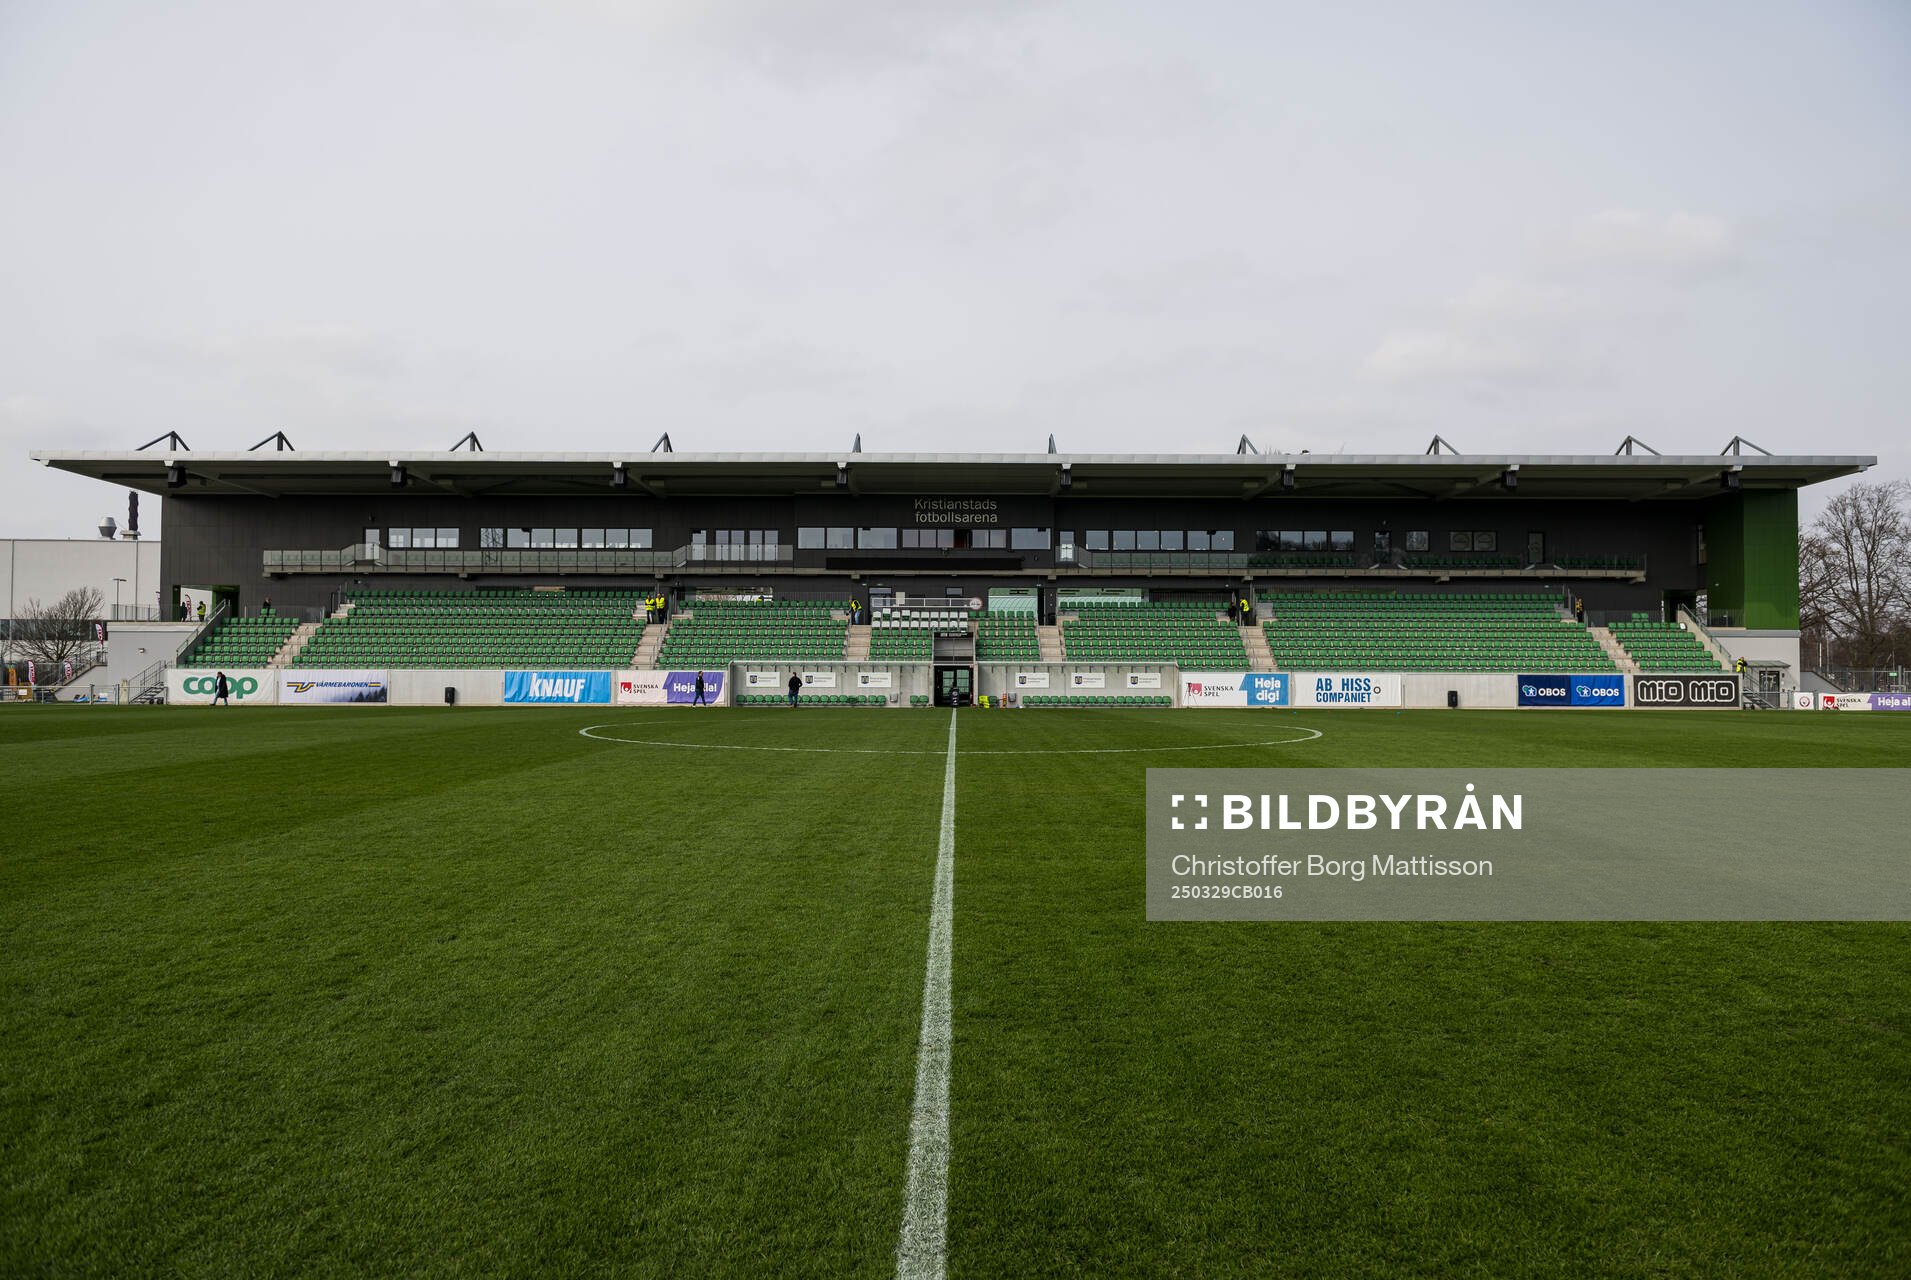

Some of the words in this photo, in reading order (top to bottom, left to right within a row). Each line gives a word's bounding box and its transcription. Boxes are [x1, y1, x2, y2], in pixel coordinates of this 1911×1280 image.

[914, 499, 998, 510] Kristianstads
[915, 511, 998, 523] fotbollsarena
[529, 673, 586, 702] KNAUF
[673, 682, 696, 694] Heja
[1254, 677, 1281, 689] Heja
[1316, 678, 1333, 691] AB
[1341, 678, 1371, 691] HISS
[1256, 690, 1280, 703] dig!
[1316, 692, 1371, 703] COMPANIET
[1538, 688, 1566, 697] OBOS
[1592, 688, 1619, 697] OBOS
[1877, 697, 1900, 707] Heja
